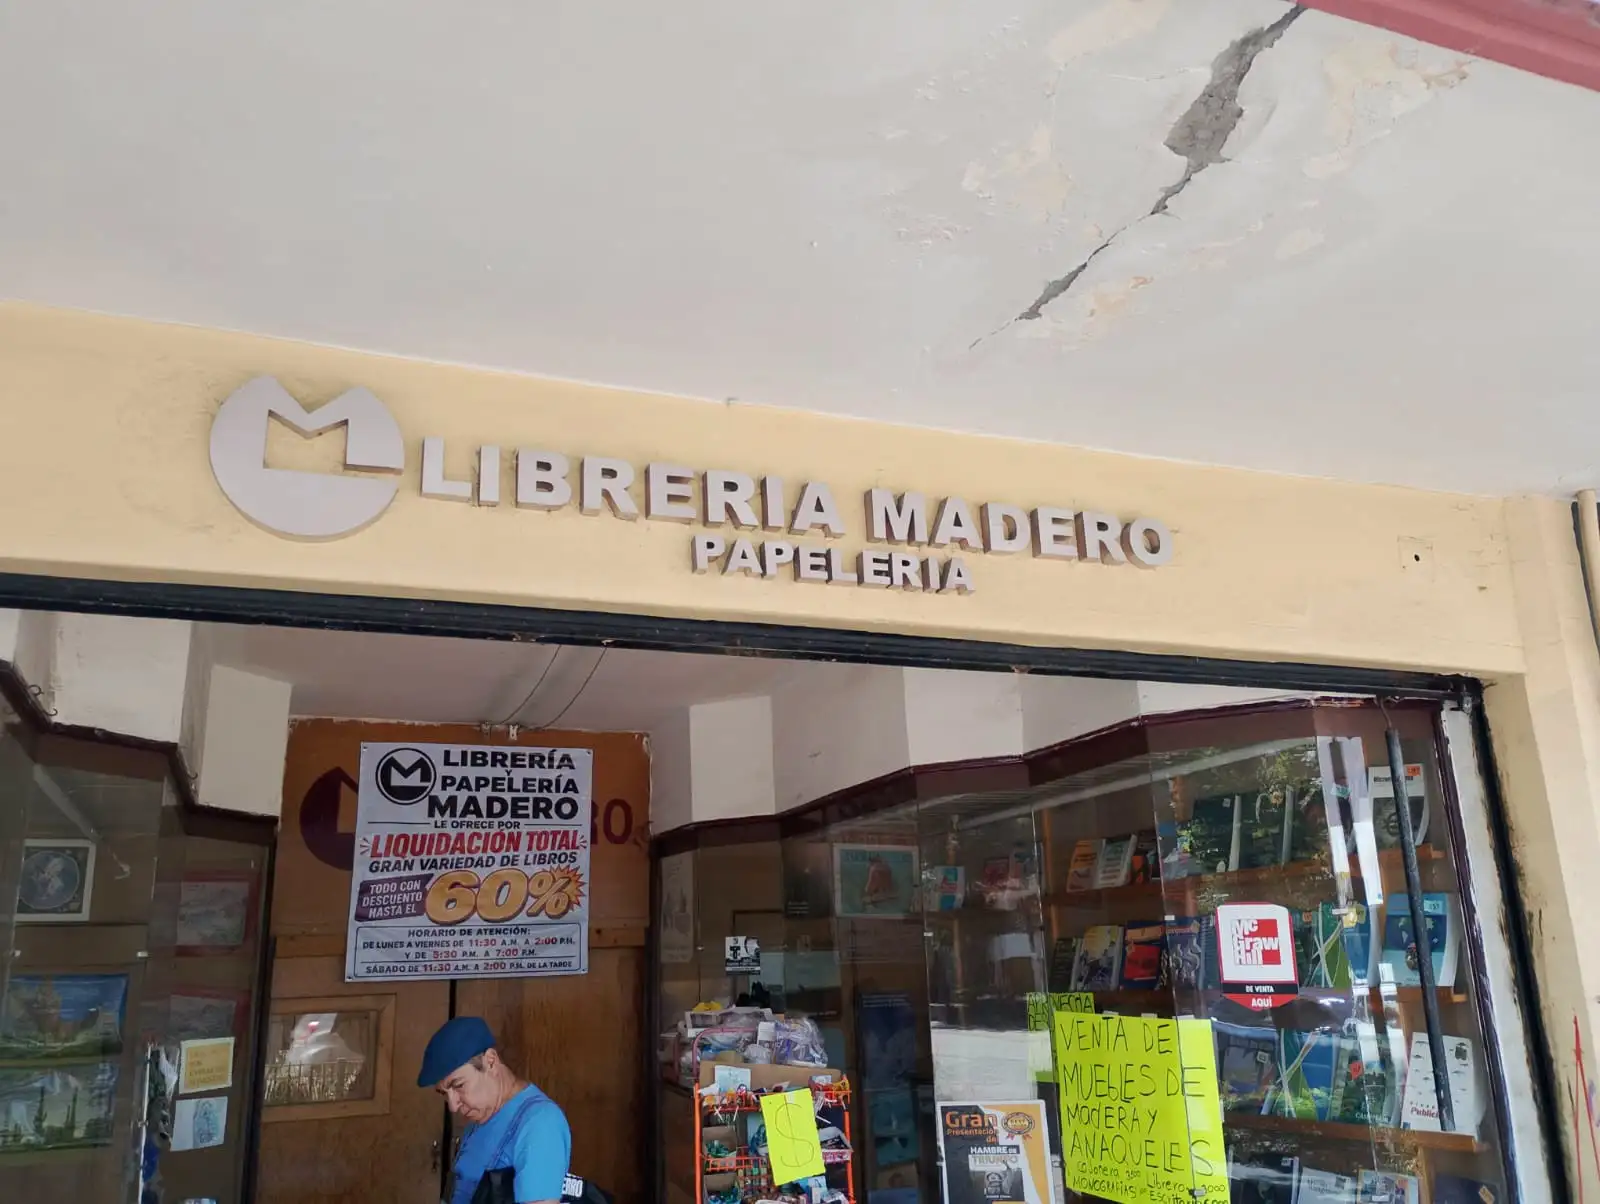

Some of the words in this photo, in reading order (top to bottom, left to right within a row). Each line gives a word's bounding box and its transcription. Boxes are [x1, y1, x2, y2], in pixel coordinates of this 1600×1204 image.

[420, 436, 847, 538] LIBRERIA
[865, 487, 1173, 570] MADERO
[692, 534, 975, 594] PAPELERIA
[443, 749, 576, 770] LIBRERÍA
[440, 775, 580, 794] PAPELERÍA
[427, 795, 579, 820] MADERO
[434, 820, 447, 829] LE
[451, 820, 495, 829] OFRECE
[498, 821, 520, 829] POR
[370, 829, 521, 858] LIQUIDACIÓN
[527, 829, 581, 850] TOTAL
[369, 860, 416, 874] GRAN
[420, 855, 496, 871] VARIEDAD
[501, 854, 519, 867] DE
[524, 851, 578, 866] LIBROS
[370, 882, 397, 894] TODO
[400, 880, 421, 891] CON
[425, 867, 575, 926] 60%
[362, 892, 422, 907] DESCUENTO
[369, 905, 402, 918] HASTA
[405, 904, 416, 914] EL
[408, 928, 456, 938] HORARIO
[460, 928, 473, 937] DE
[476, 926, 531, 936] ATENCIÓN:
[363, 941, 375, 950] DE
[376, 940, 405, 949] LUNES
[406, 940, 413, 949] A
[414, 939, 451, 948] VIERNES
[453, 939, 464, 948] DE
[469, 938, 497, 947] 11:30
[524, 938, 530, 946] A
[534, 937, 558, 945] 2:00
[414, 951, 427, 959] DE
[495, 948, 519, 957] 7:00
[366, 964, 406, 975] SÁBADO
[407, 965, 419, 973] DE
[422, 963, 451, 972] 11:30
[483, 962, 506, 971] 2:00
[537, 961, 547, 969] LA
[549, 960, 573, 968] TARDE
[1254, 985, 1275, 993] VENTA
[1060, 1016, 1128, 1052] VENTA
[1143, 1022, 1173, 1054] DE
[1166, 1067, 1207, 1098] DE
[945, 1110, 998, 1128] Gran
[775, 1095, 815, 1167] $
[970, 1146, 1008, 1154] HAMBRE
[1071, 1131, 1214, 1177] ANAQUELES
